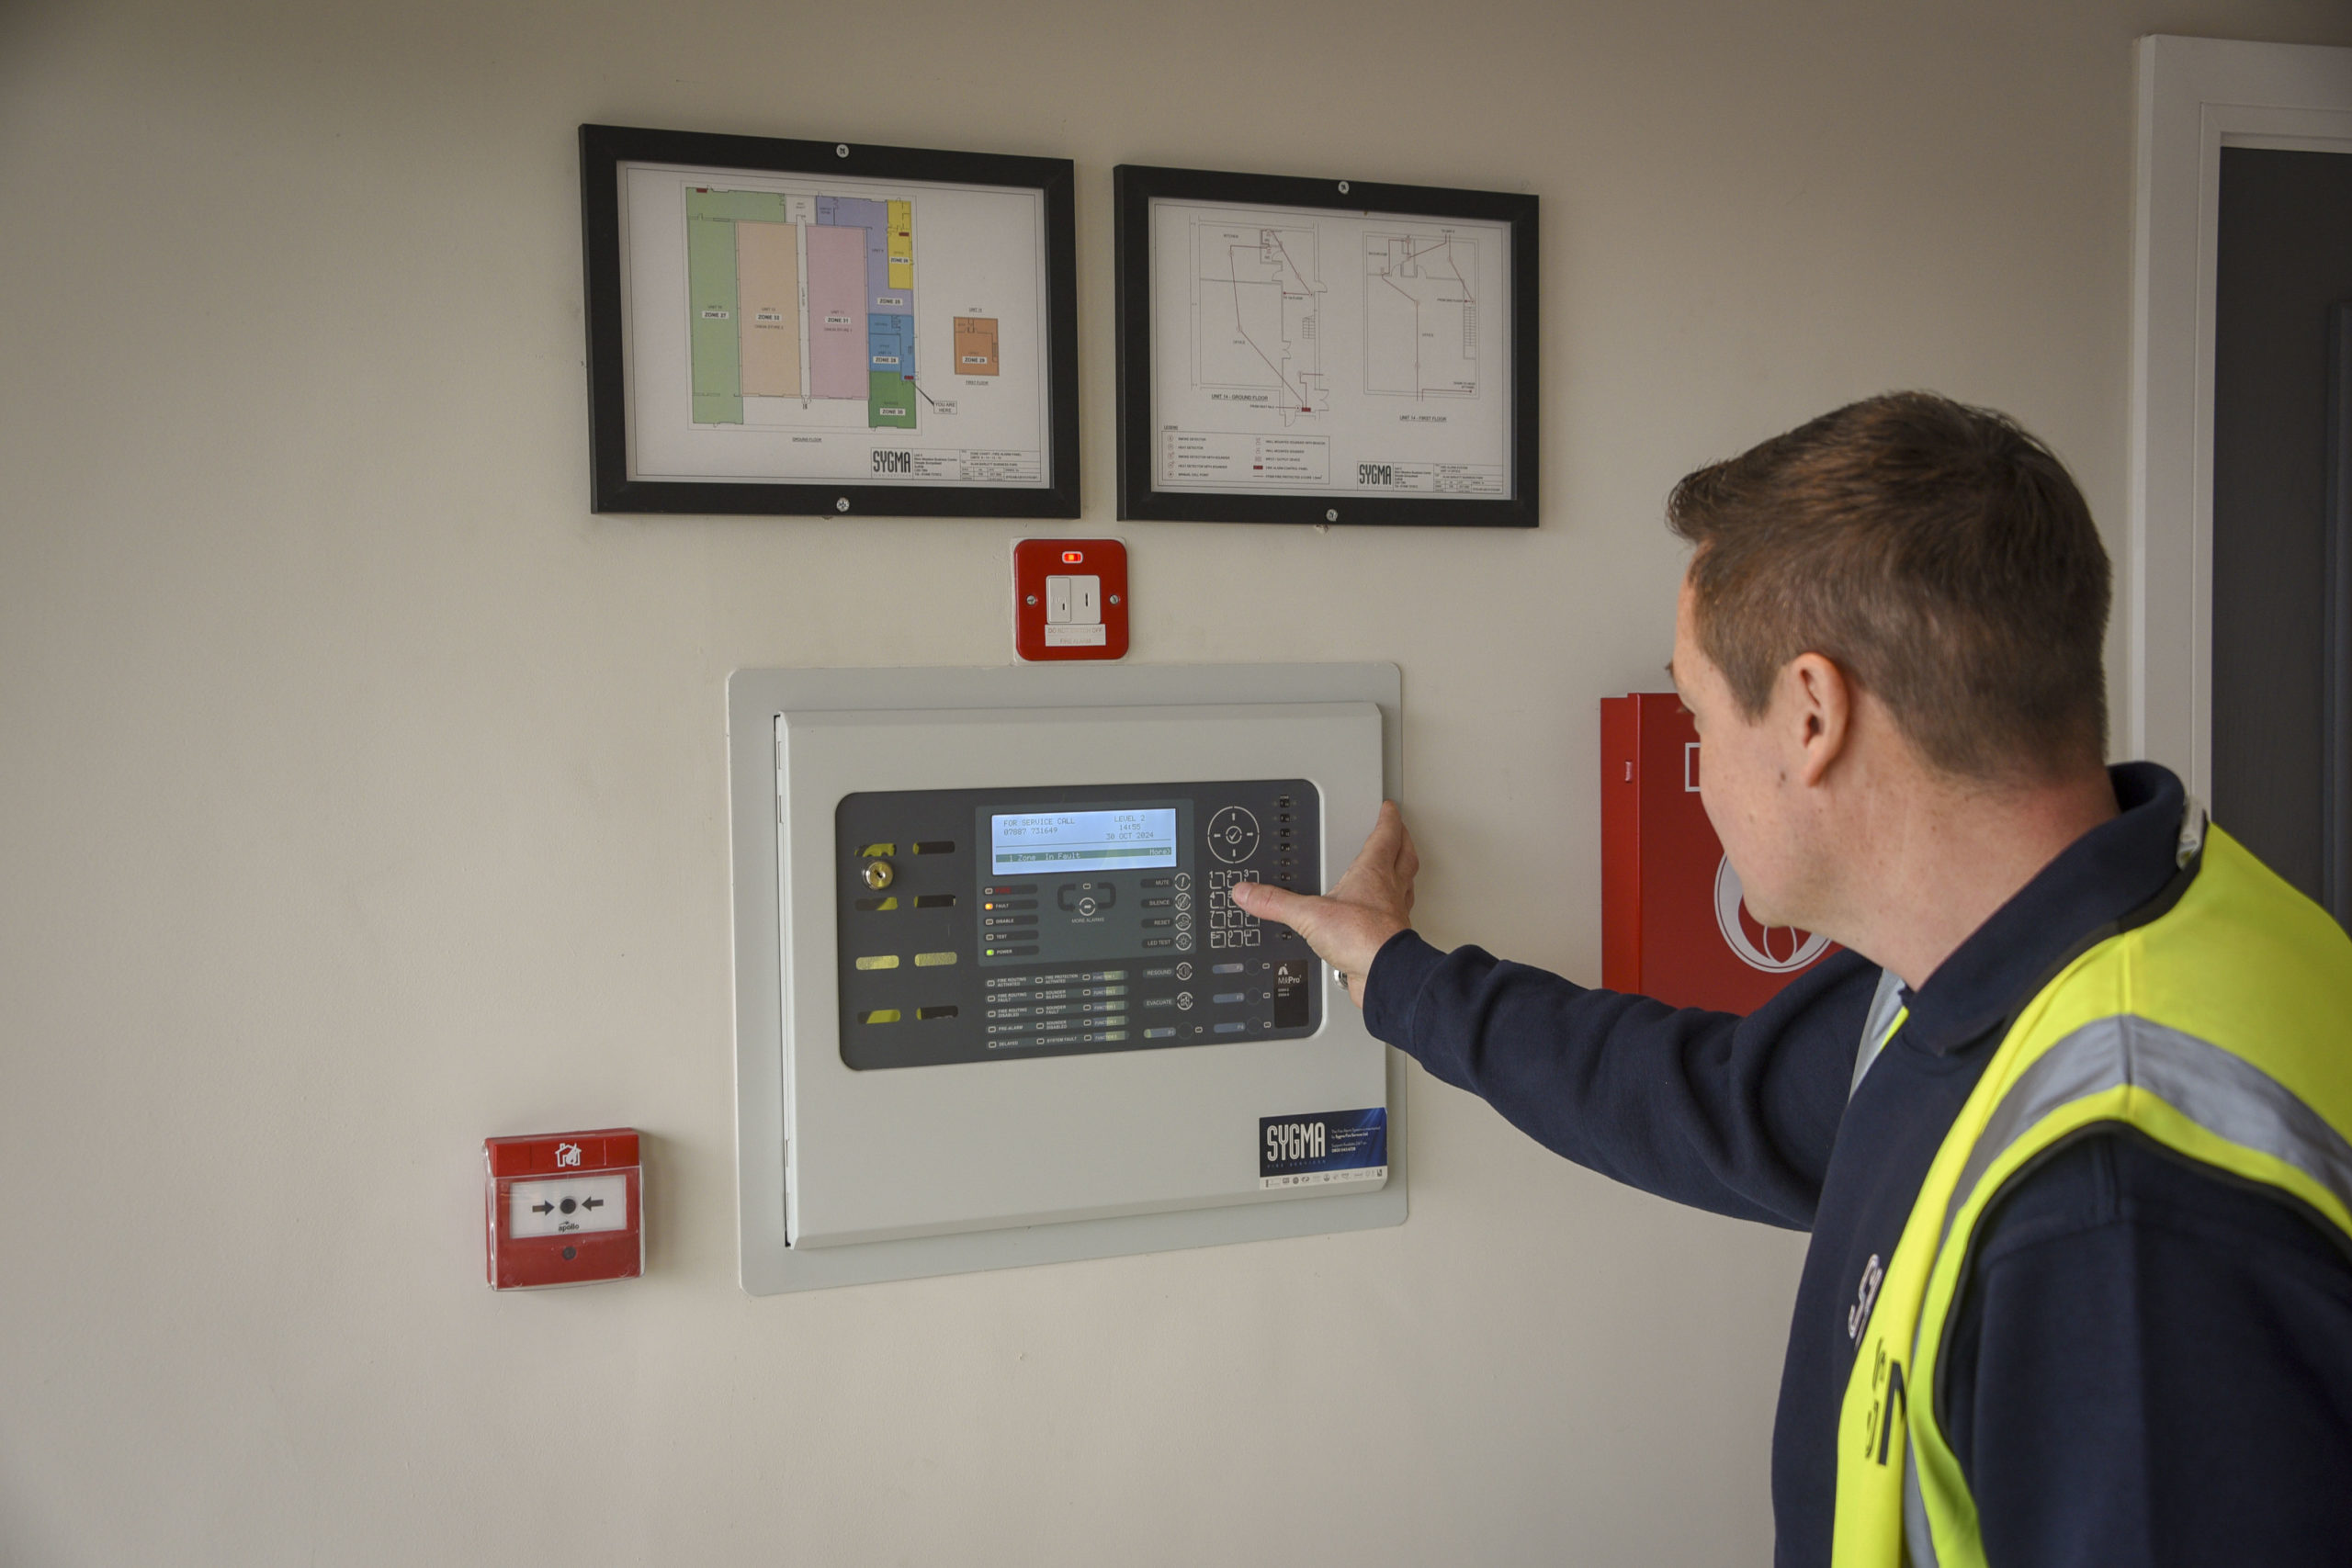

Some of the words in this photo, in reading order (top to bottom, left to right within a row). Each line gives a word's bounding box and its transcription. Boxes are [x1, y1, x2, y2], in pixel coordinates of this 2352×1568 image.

[873, 450, 911, 474] SYGMA
[1359, 464, 1392, 485] SYGMA
[1022, 818, 1053, 826] SERVICE
[1057, 817, 1075, 825] CALL
[1114, 815, 1136, 823] LEVEL
[1003, 828, 1026, 836] 07887
[1031, 827, 1058, 835] 731649
[1136, 830, 1154, 839] 2024
[1045, 852, 1055, 861] In
[1057, 852, 1080, 860] Fault
[1209, 870, 1214, 879] 1
[1227, 870, 1232, 878] 2
[1244, 869, 1250, 877] 3
[1209, 891, 1216, 899] 4
[1210, 910, 1215, 919] 7
[1227, 931, 1233, 939] 0
[1267, 1122, 1326, 1162] SYGMA
[559, 1223, 580, 1233] apollo
